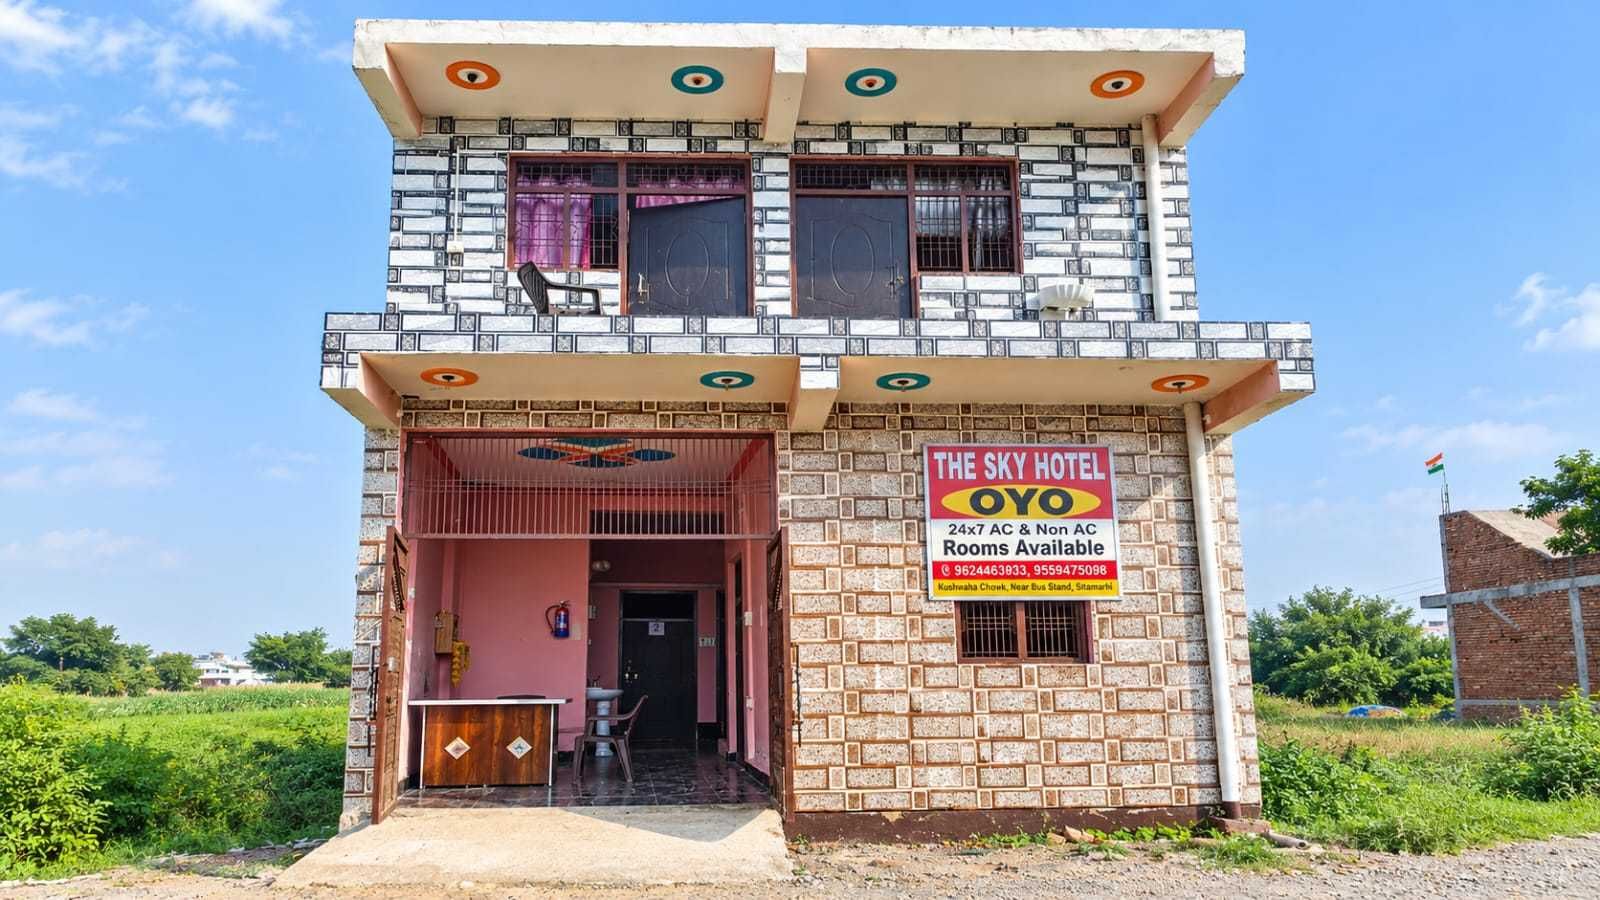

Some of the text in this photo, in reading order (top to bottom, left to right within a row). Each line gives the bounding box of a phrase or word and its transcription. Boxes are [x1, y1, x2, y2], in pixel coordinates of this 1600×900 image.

[933, 451, 1106, 480] THE SKY HOTEL
[969, 487, 1074, 516] OYO
[948, 524, 1097, 536] 24x7 AC & Non AC
[943, 539, 1105, 556] Rooms Available
[1010, 582, 1029, 591] Near
[1031, 582, 1046, 591] Bus
[1048, 582, 1074, 593] Stand,
[1075, 582, 1113, 592] Sitamarhi
